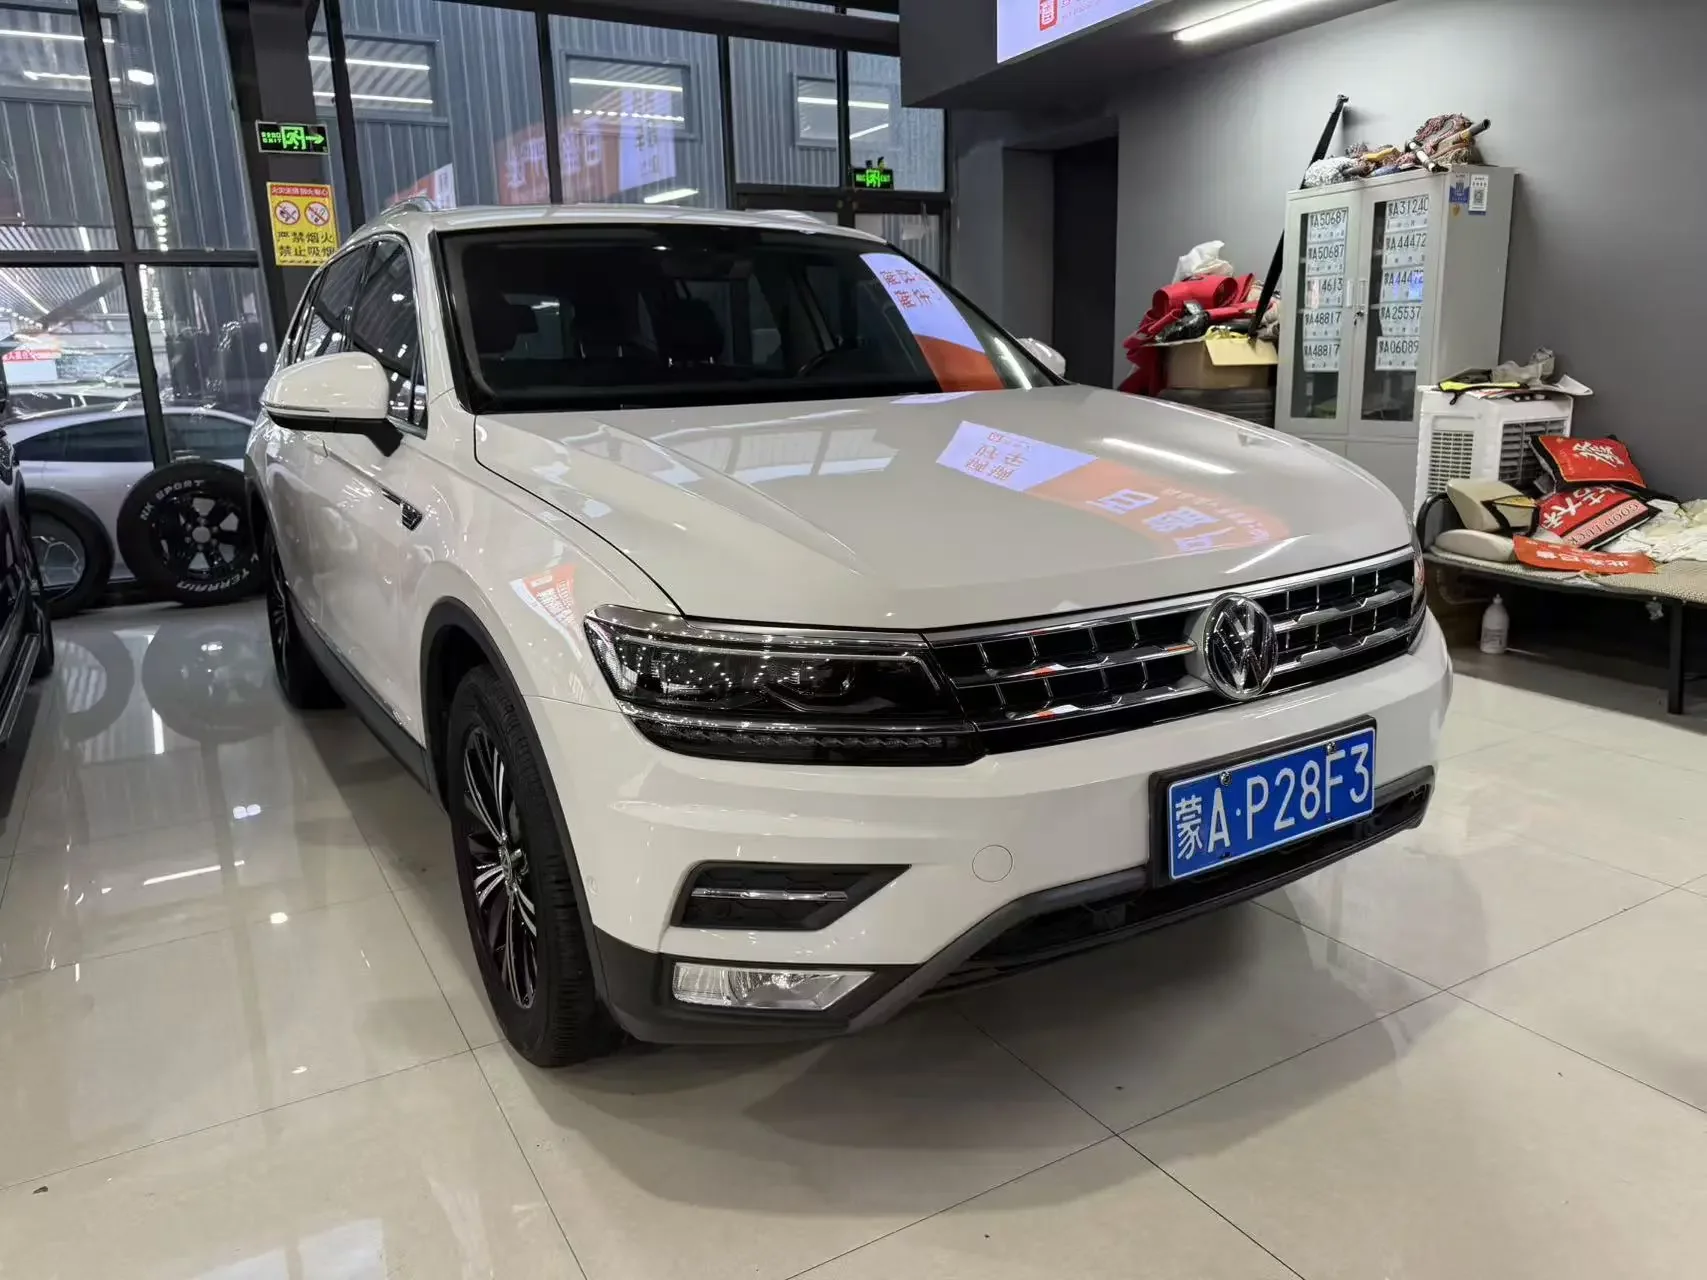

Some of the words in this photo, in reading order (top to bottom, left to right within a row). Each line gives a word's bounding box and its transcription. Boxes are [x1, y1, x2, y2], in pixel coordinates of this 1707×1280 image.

[277, 231, 335, 243] 严禁烟火
[279, 245, 336, 257] 禁止吸烟
[156, 480, 205, 500] SPORT
[1605, 502, 1641, 527] GOOD
[1567, 521, 1606, 547] LUCK
[1175, 743, 1370, 860] 蒙A·P28F3
